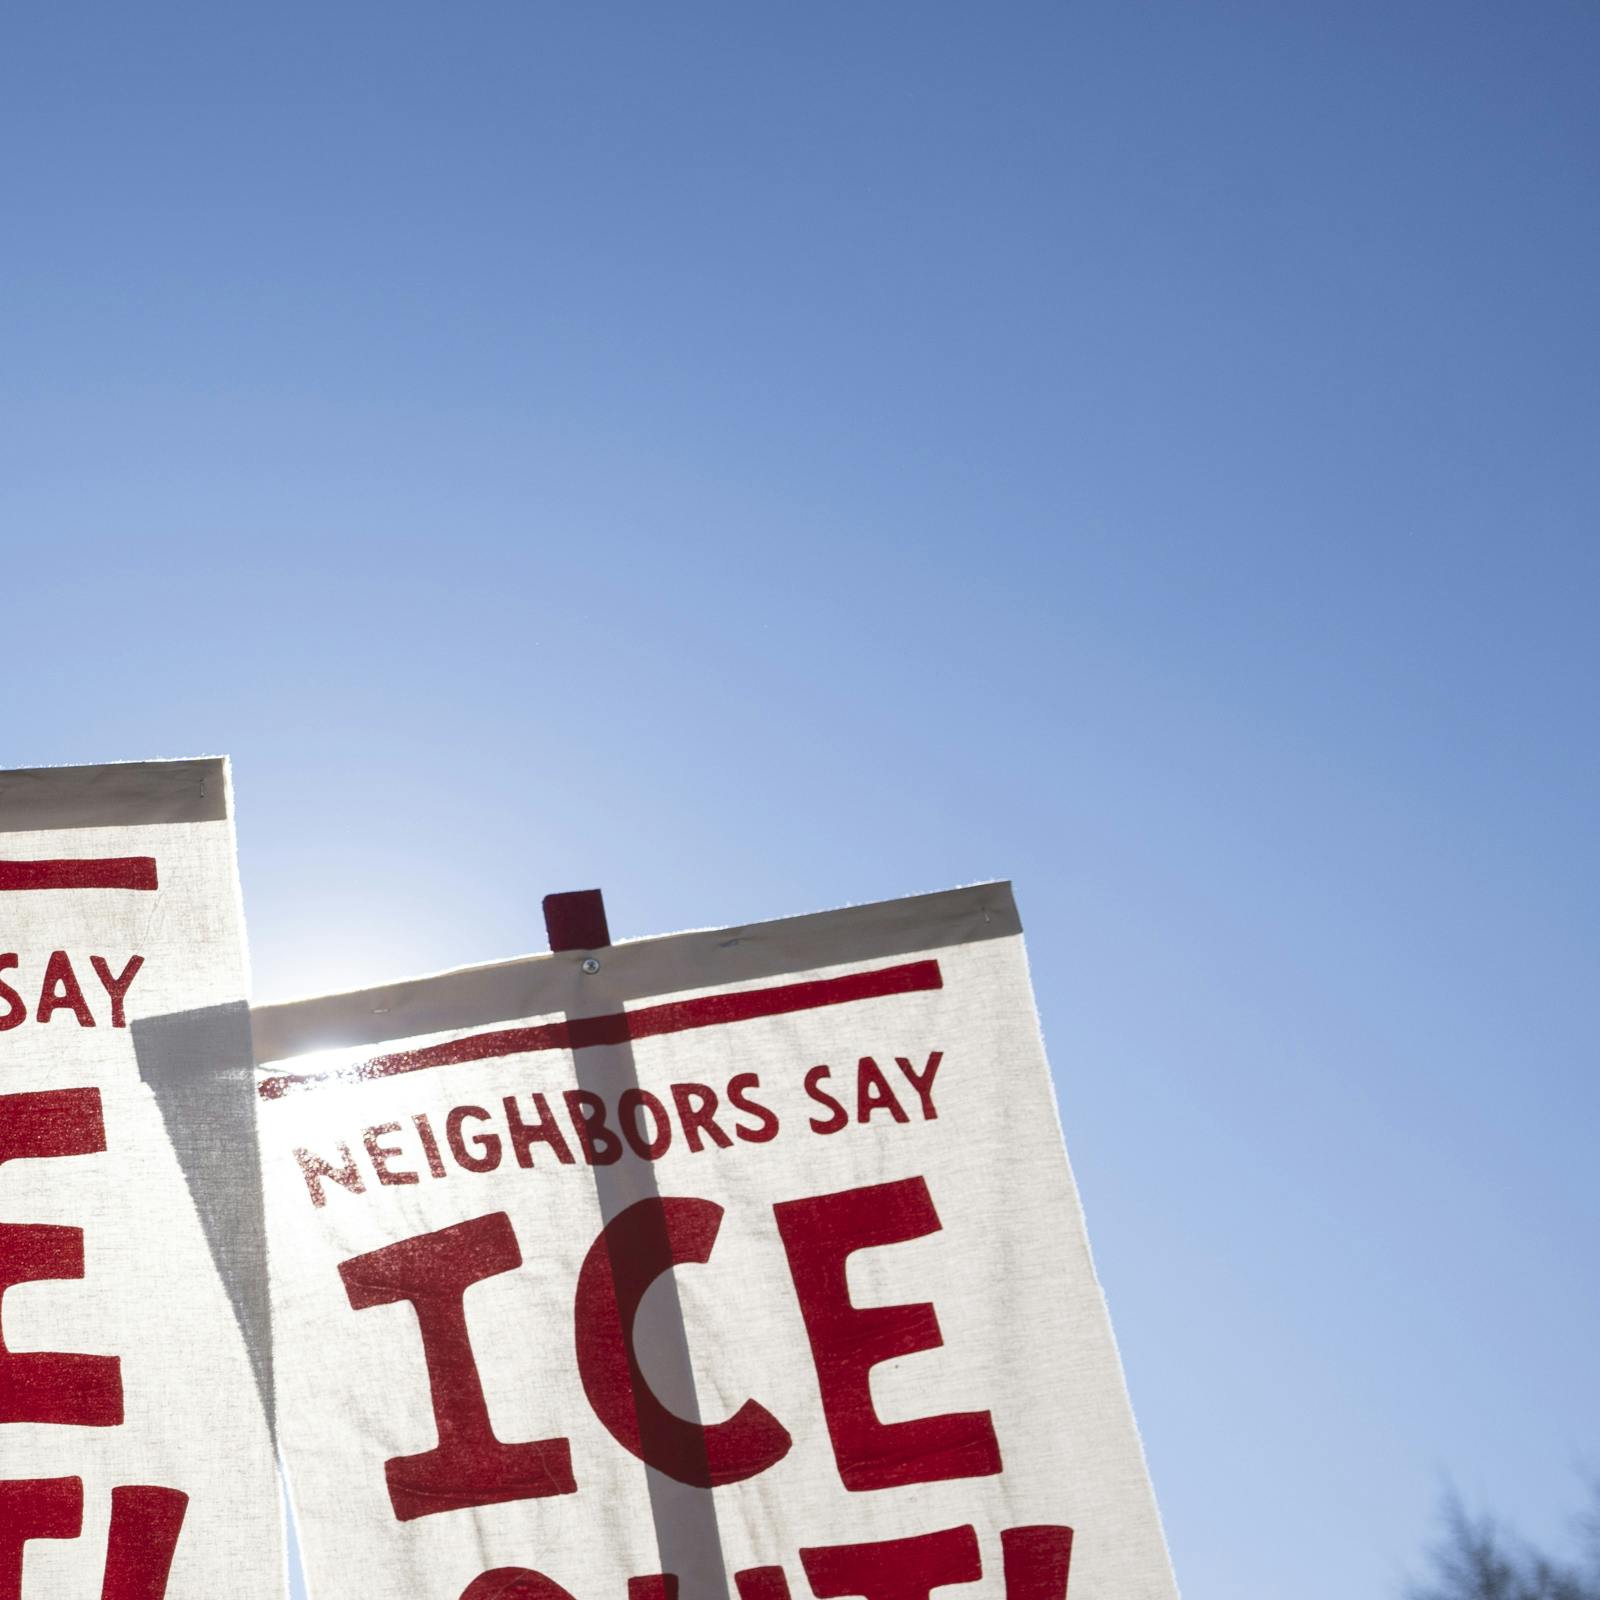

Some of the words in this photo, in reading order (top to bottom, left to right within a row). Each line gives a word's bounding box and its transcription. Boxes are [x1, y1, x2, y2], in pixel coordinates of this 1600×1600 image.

[293, 1072, 779, 1208] NEIGHBORS
[805, 1050, 944, 1137] SAY
[336, 1175, 1004, 1523] ICE
